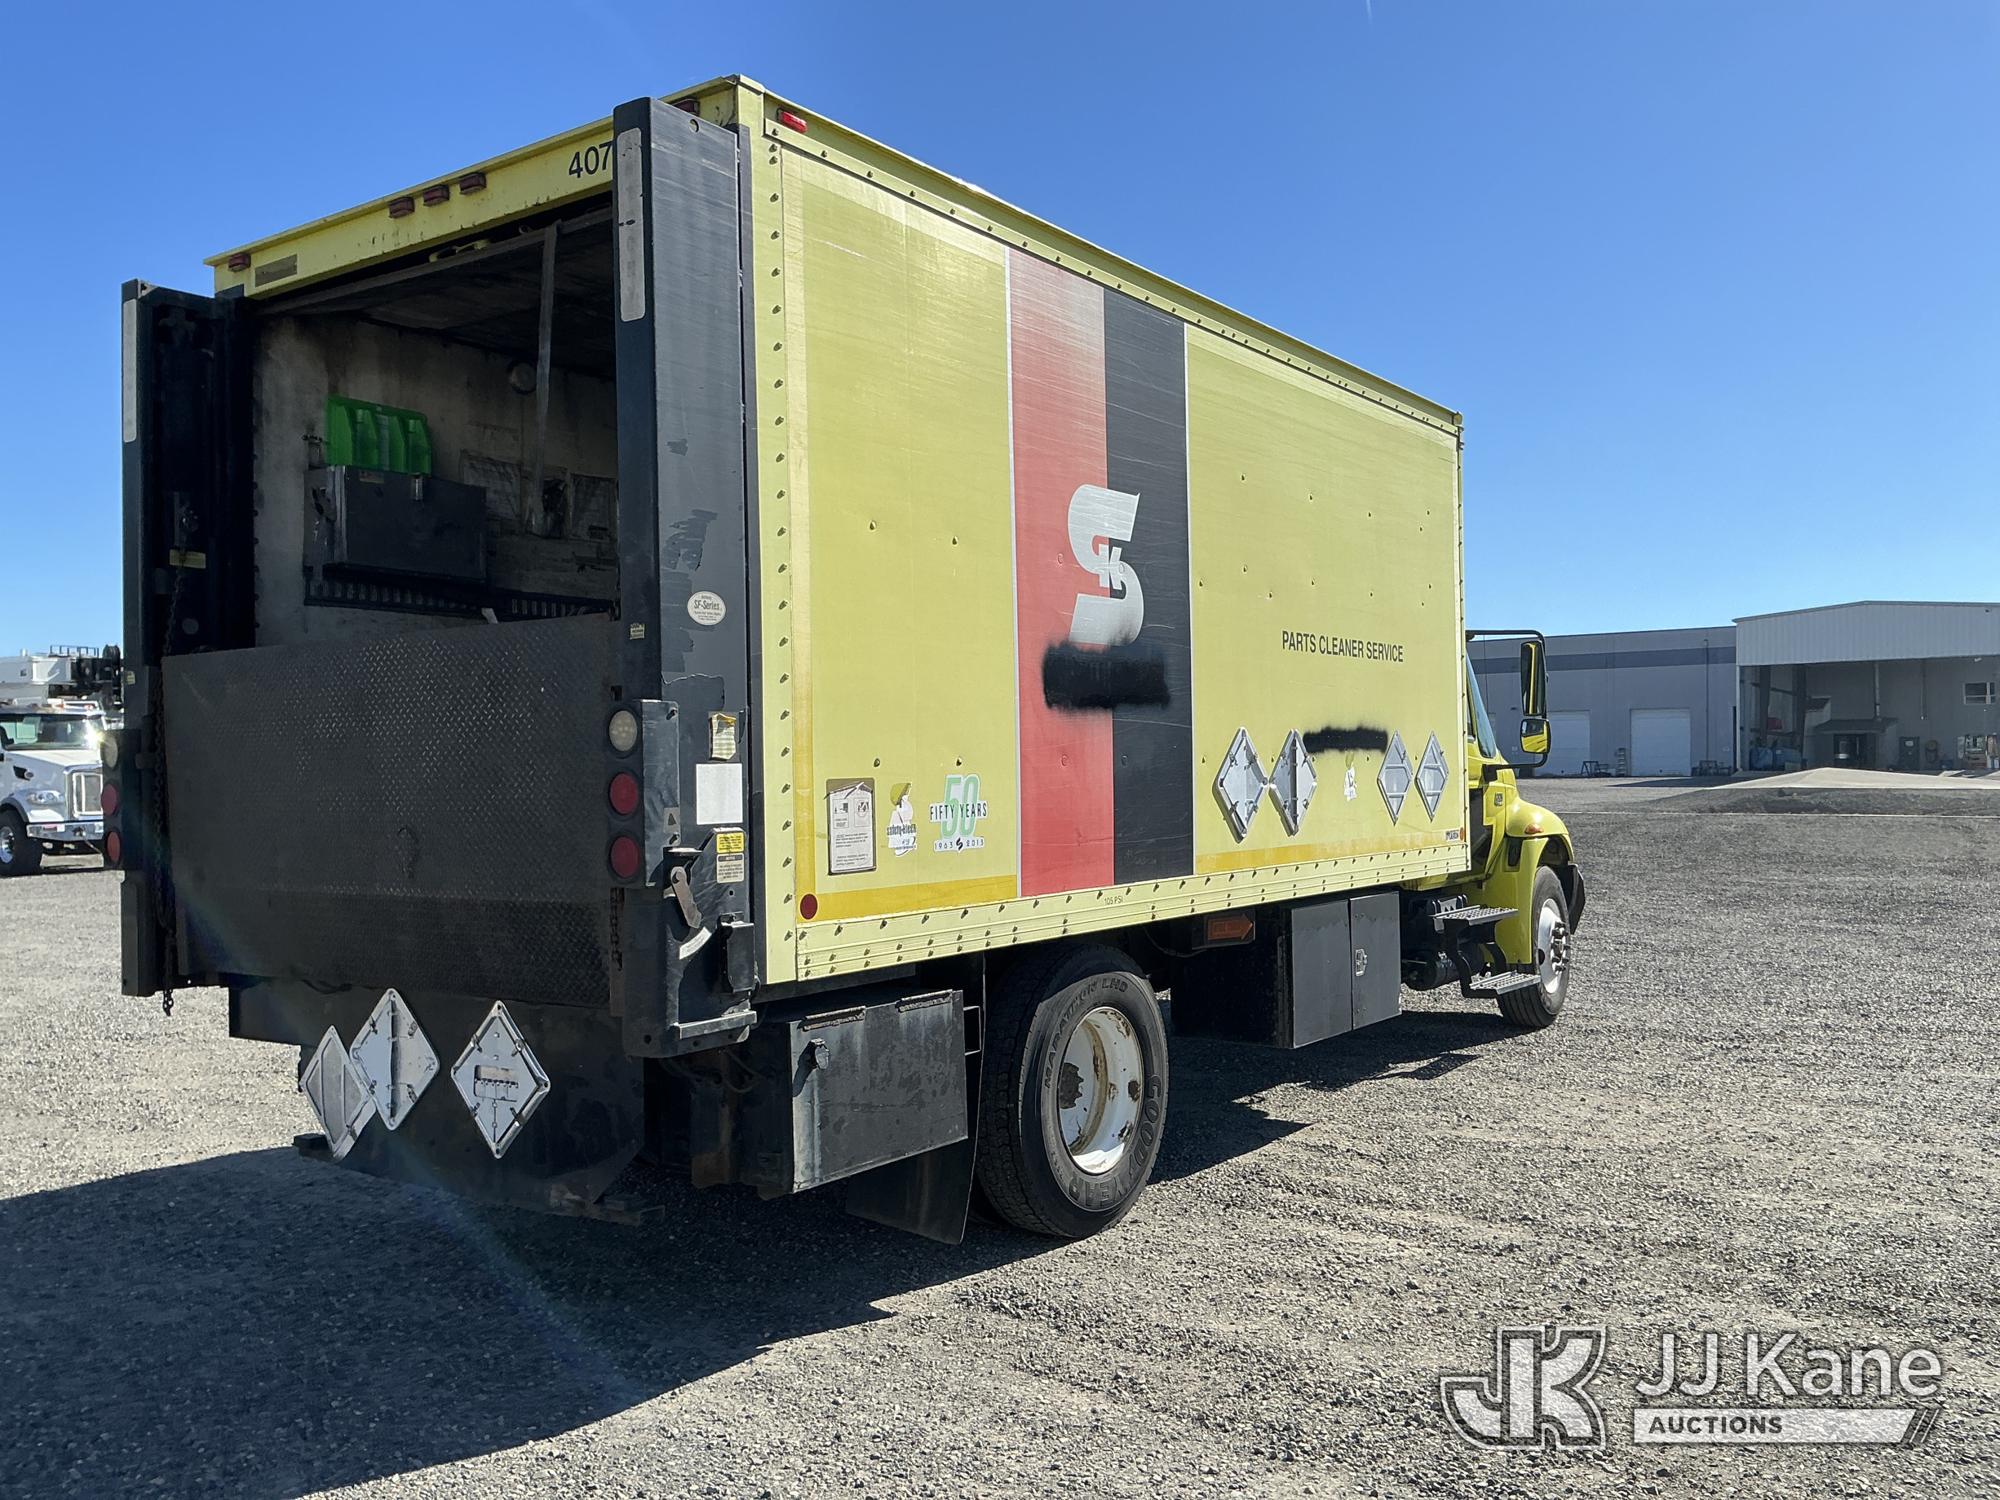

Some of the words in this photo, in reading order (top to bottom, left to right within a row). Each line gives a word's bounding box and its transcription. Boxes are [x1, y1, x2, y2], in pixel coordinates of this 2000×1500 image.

[568, 141, 613, 178] 407
[1282, 630, 1316, 653] PARTS
[1319, 635, 1364, 658] CLEANER
[1366, 641, 1404, 662] SERVICE
[930, 804, 955, 820] FIFTY
[960, 803, 987, 818] YEARS
[942, 776, 979, 837] 50
[934, 841, 954, 850] 1963
[1102, 978, 1129, 993] LHD
